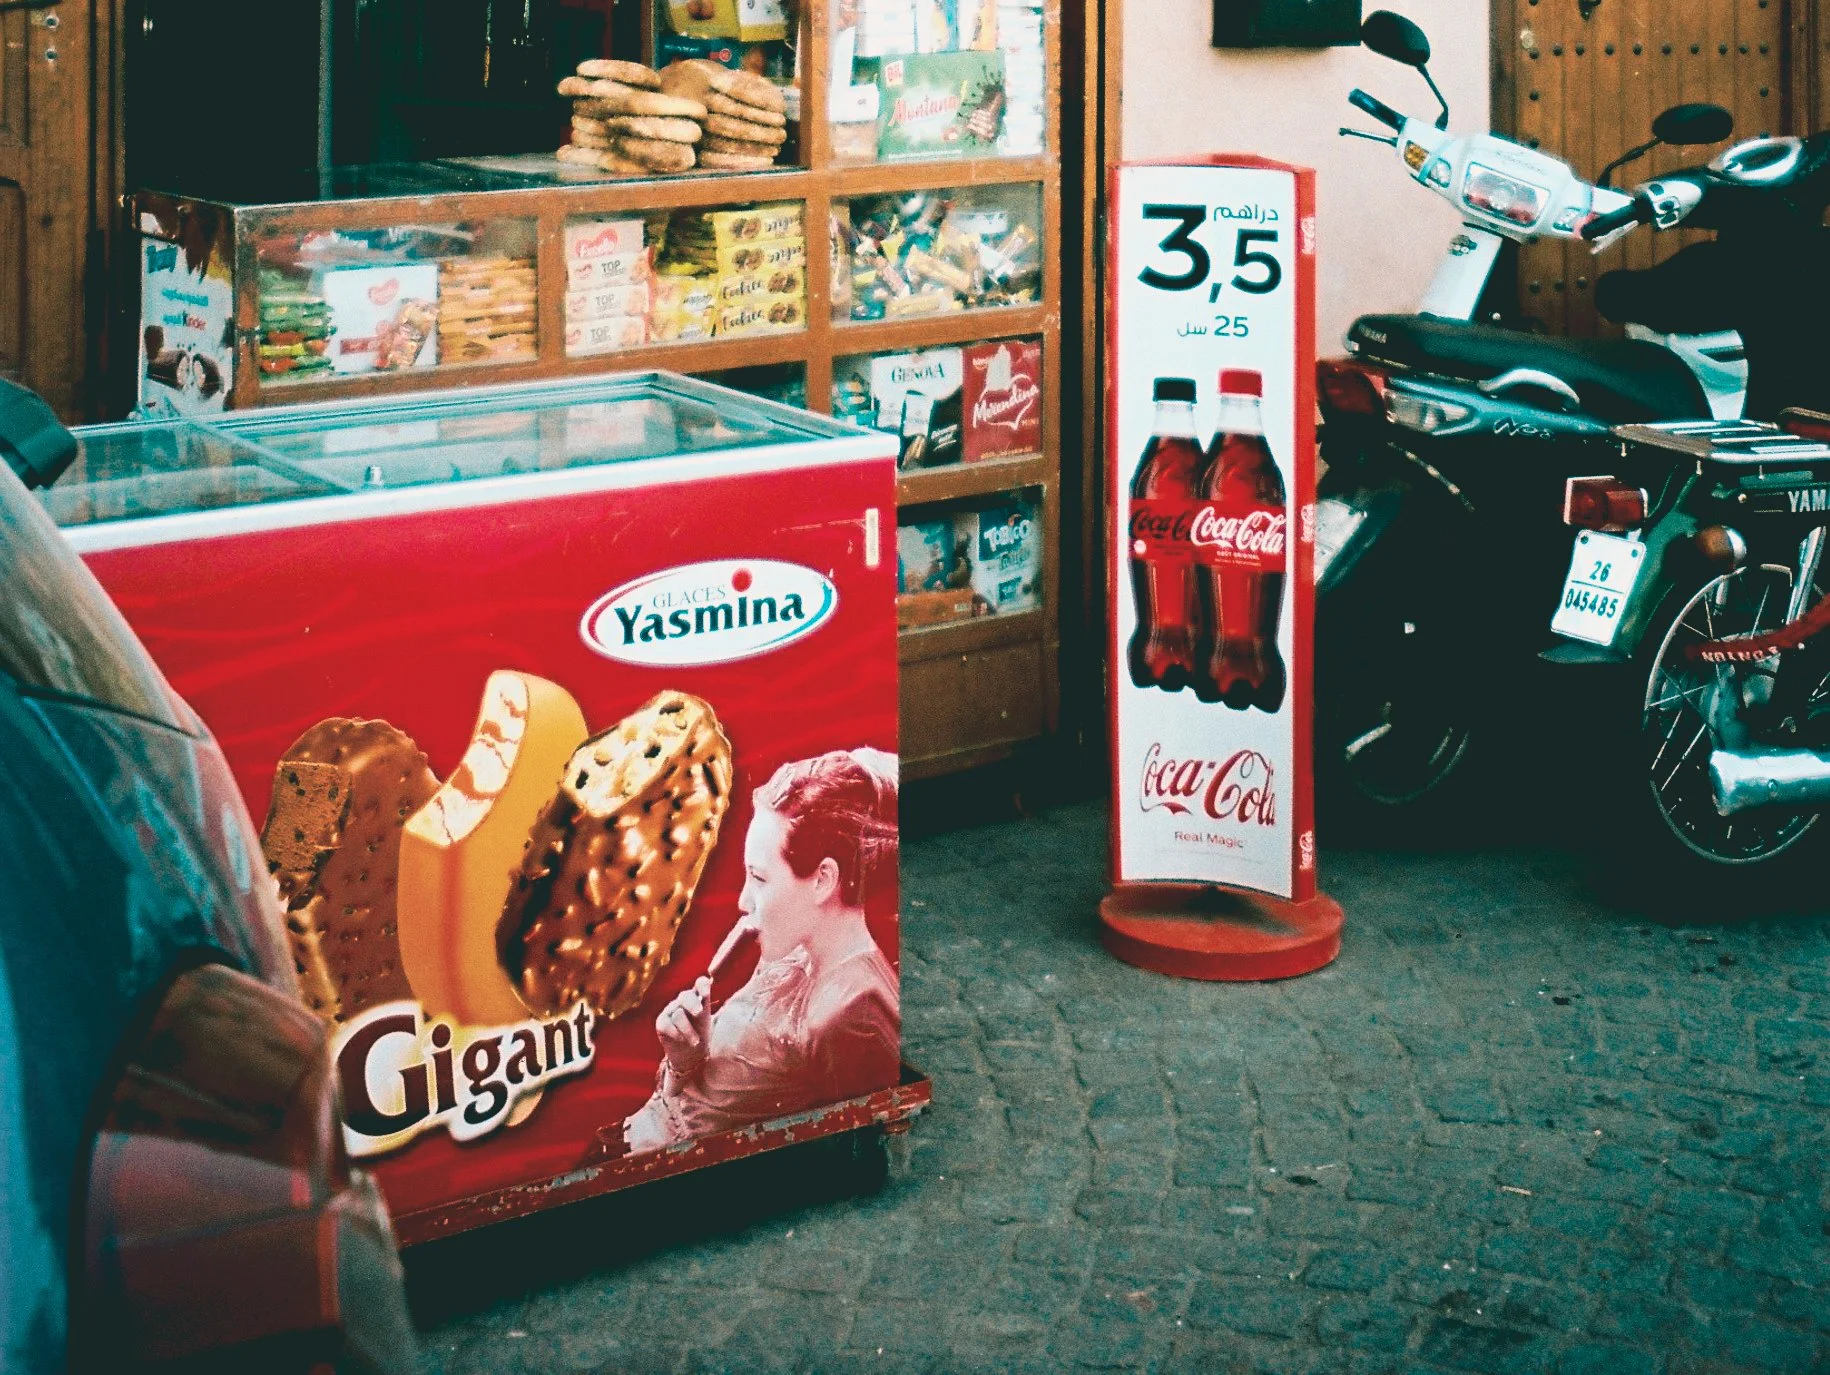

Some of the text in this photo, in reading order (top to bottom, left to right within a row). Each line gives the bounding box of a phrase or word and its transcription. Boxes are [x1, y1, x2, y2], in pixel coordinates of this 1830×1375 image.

[1214, 204, 1279, 224] دراهم
[1137, 203, 1282, 304] 3,5
[602, 260, 621, 273] TOP
[596, 294, 614, 306] TOP
[590, 326, 610, 339] TOP
[1214, 315, 1249, 338] 25
[891, 363, 945, 384] GENOVA
[1788, 489, 1830, 513] YAM
[1190, 506, 1287, 555] Coca-Cola
[1589, 560, 1612, 582] 26
[614, 568, 805, 645] Yasmina
[653, 585, 727, 609] GLACES
[1565, 588, 1619, 619] 045485
[1140, 742, 1276, 826] Coca-Cola
[1174, 830, 1245, 849] Real Magic
[337, 1002, 594, 1138] Gigant
